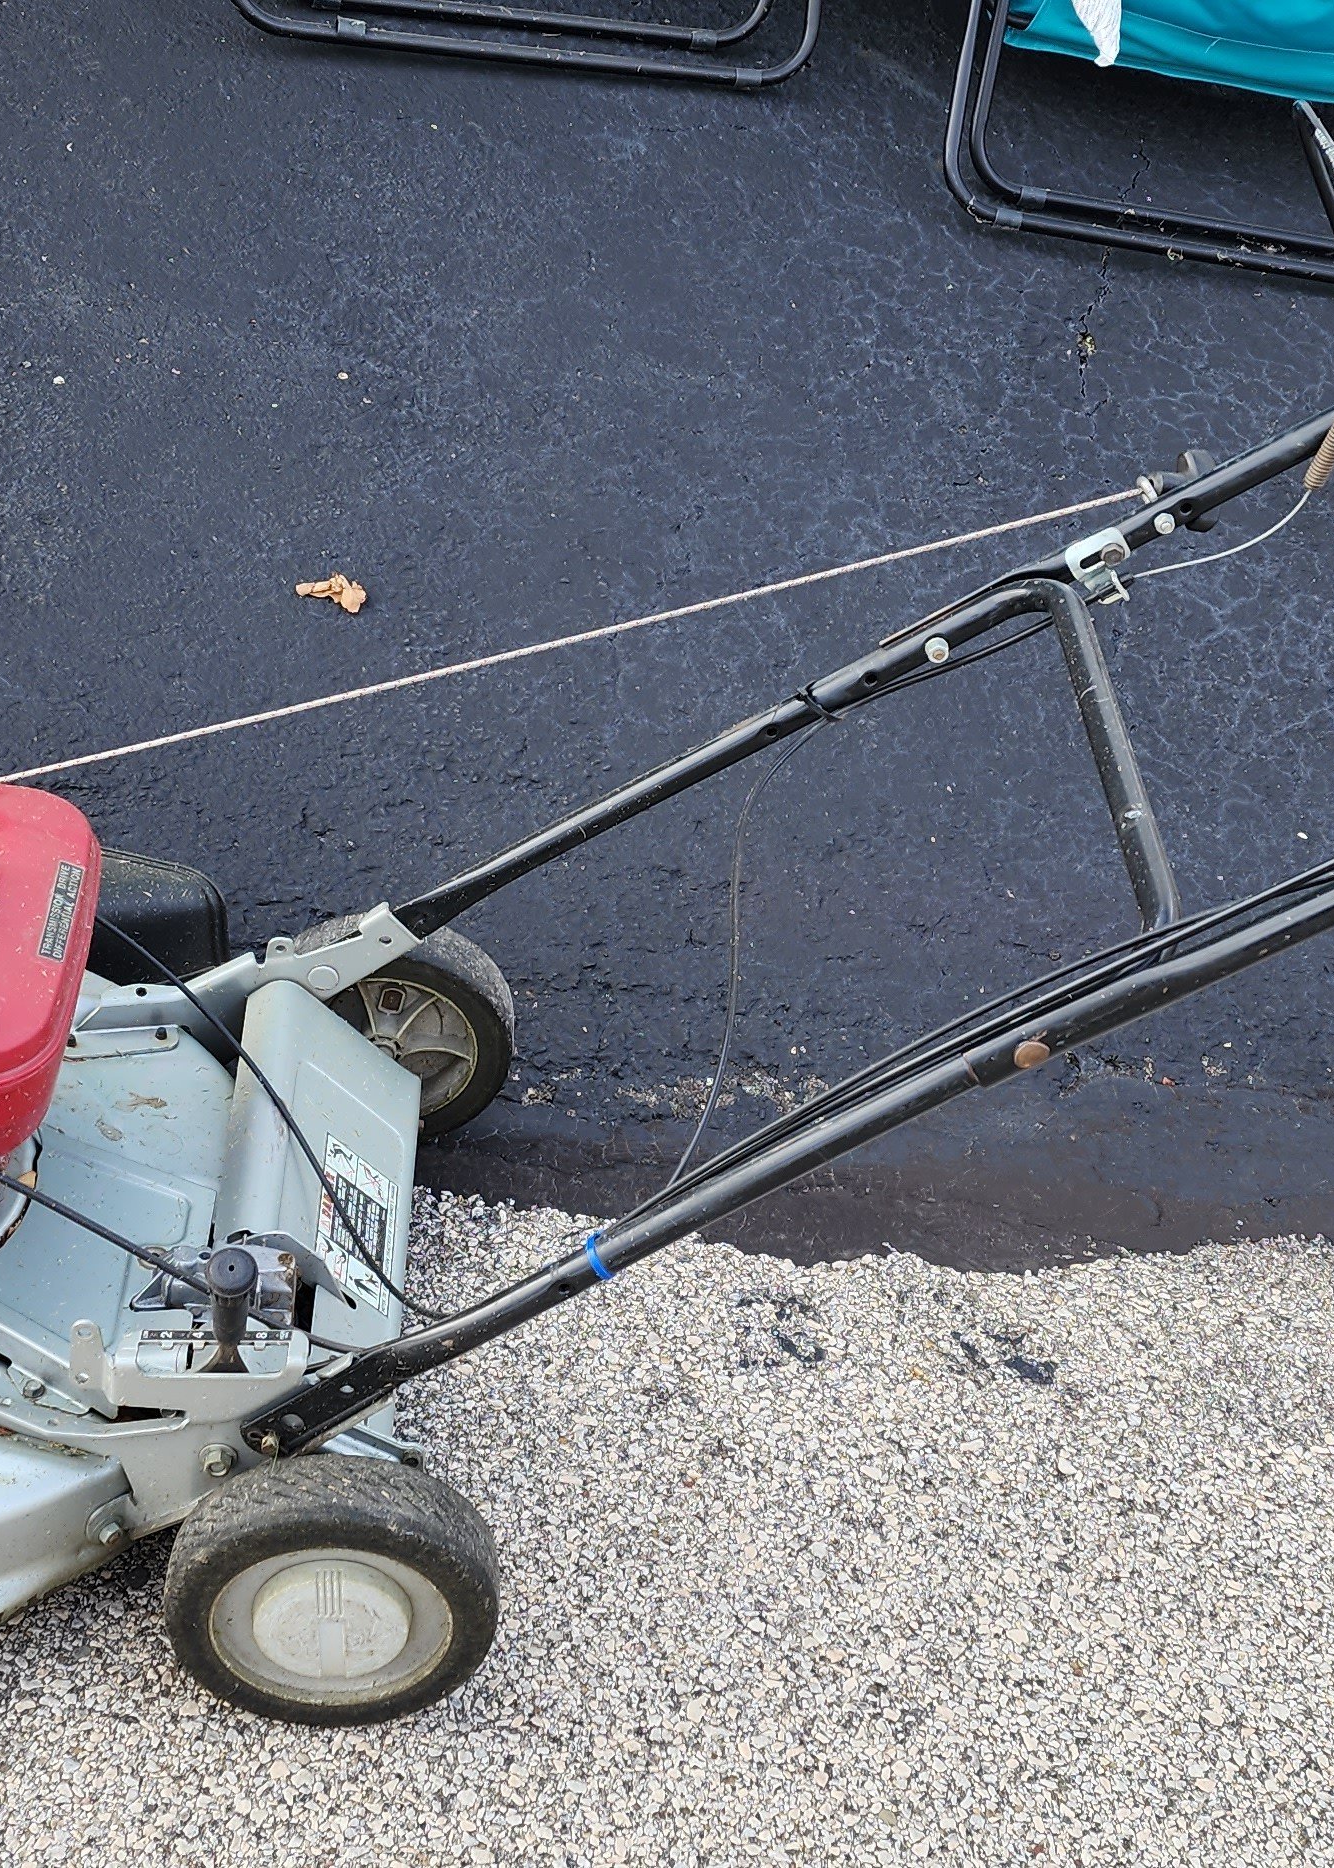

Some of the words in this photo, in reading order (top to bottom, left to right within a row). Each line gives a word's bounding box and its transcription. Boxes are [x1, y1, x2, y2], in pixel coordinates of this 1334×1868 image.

[41, 893, 64, 955] TRANSMISSION
[57, 864, 71, 890] DRIVE
[52, 901, 75, 959] DIFFERENTIAL
[66, 867, 82, 899] ACTION
[159, 1331, 173, 1339] 2
[192, 1331, 205, 1339] 4
[255, 1331, 268, 1340] 8
